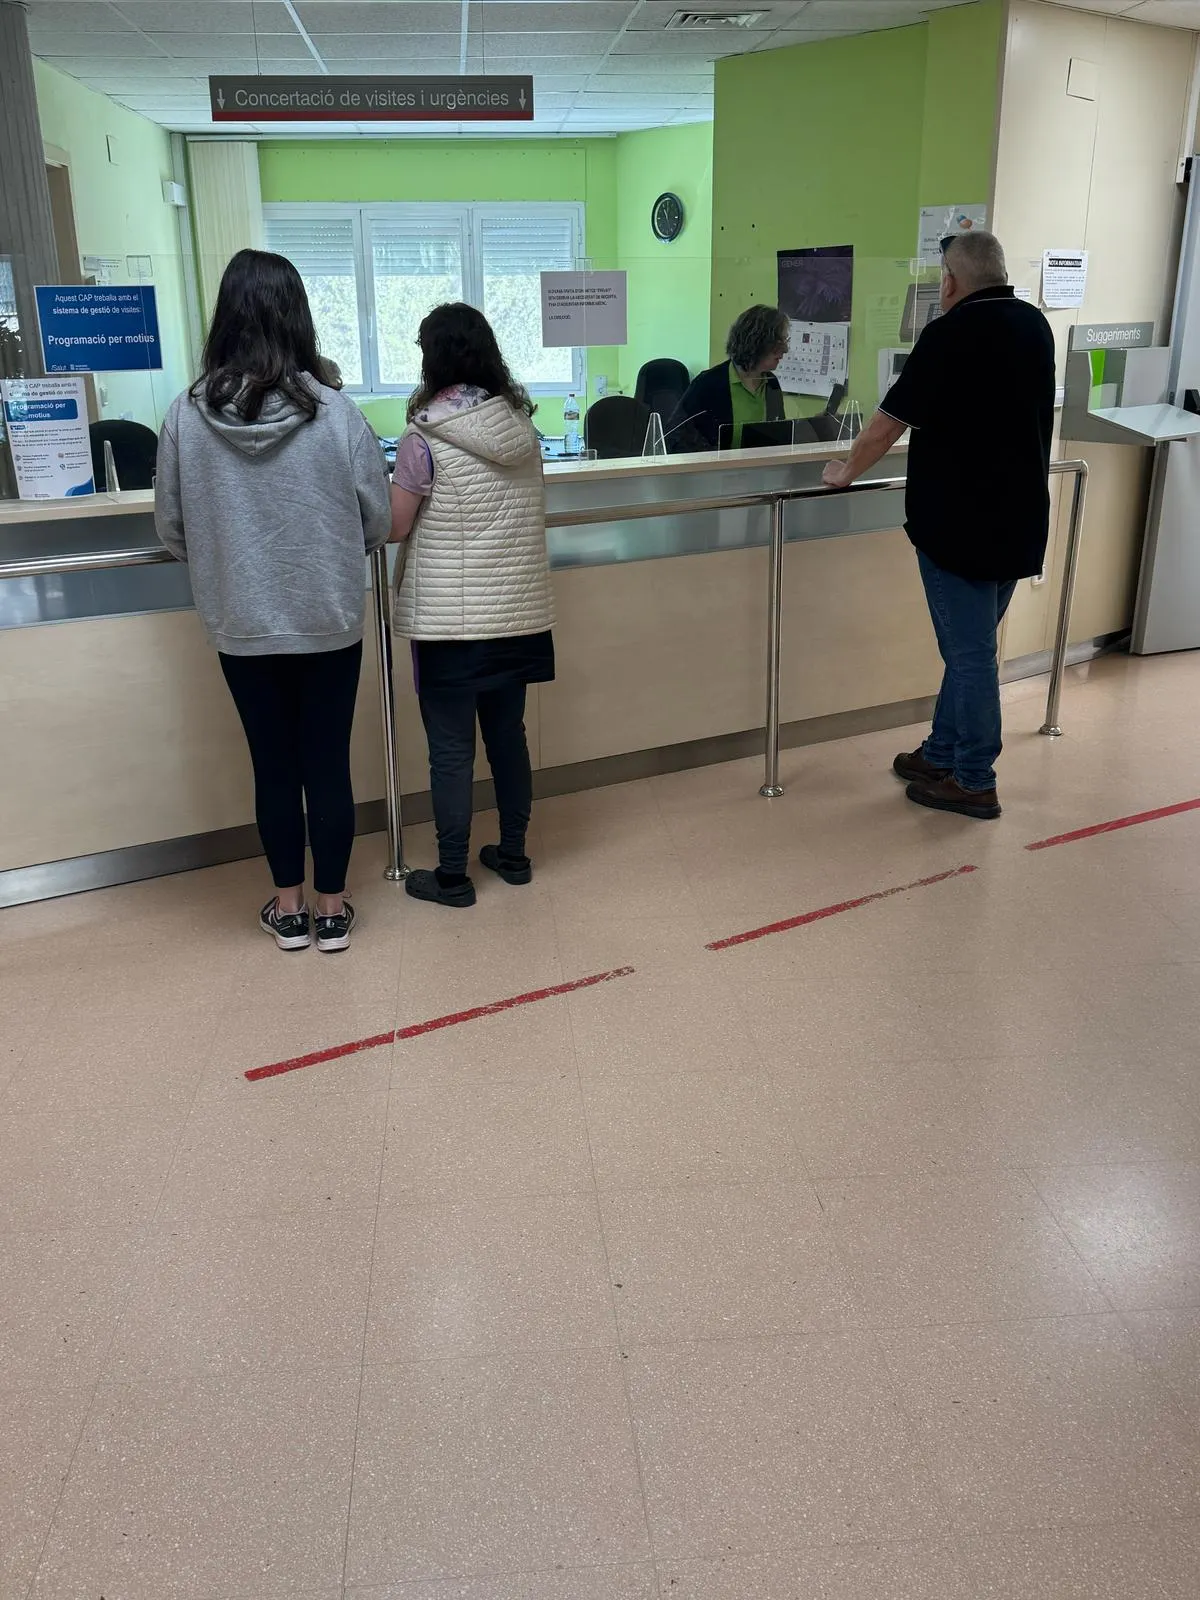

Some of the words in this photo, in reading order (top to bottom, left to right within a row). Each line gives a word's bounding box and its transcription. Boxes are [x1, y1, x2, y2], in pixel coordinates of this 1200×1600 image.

[235, 88, 335, 107] Concertació
[339, 88, 361, 107] de
[364, 89, 415, 107] visites
[420, 89, 425, 106] i
[430, 88, 509, 110] urgències
[55, 294, 77, 303] Aquest
[78, 294, 92, 302] CAP
[93, 294, 117, 302] treballa
[52, 306, 79, 315] sistema
[80, 306, 89, 314] de
[90, 306, 111, 316] gestió
[111, 306, 120, 314] de
[47, 334, 106, 347] Programació
[108, 335, 123, 346] per
[125, 333, 155, 343] motius
[1086, 328, 1141, 344] Suggeriments
